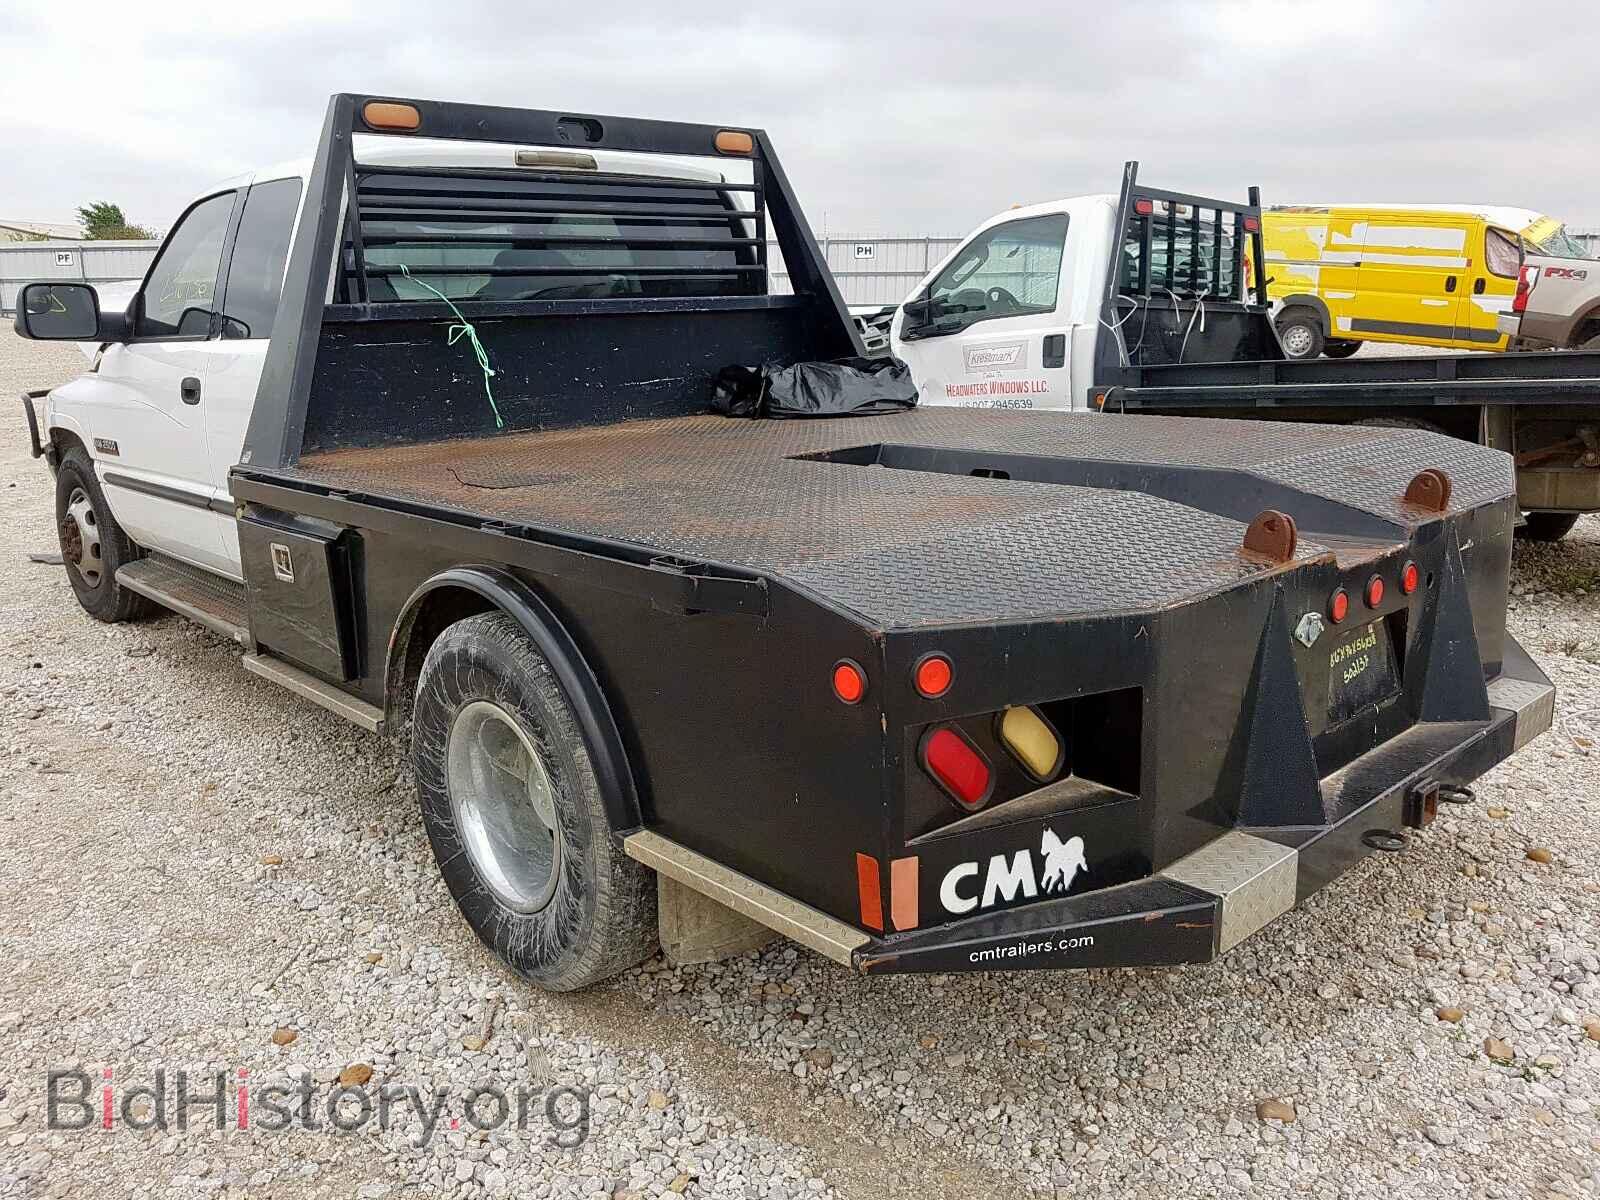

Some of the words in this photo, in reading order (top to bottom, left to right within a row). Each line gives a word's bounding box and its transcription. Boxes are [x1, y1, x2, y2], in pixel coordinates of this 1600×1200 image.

[857, 246, 872, 255] PH
[58, 254, 71, 262] PF
[1544, 268, 1588, 280] FX4
[990, 380, 1030, 394] WINDOWS
[991, 399, 1033, 409] 2945639
[940, 848, 1039, 914] CM
[969, 935, 1094, 962] cmtrailers.com
